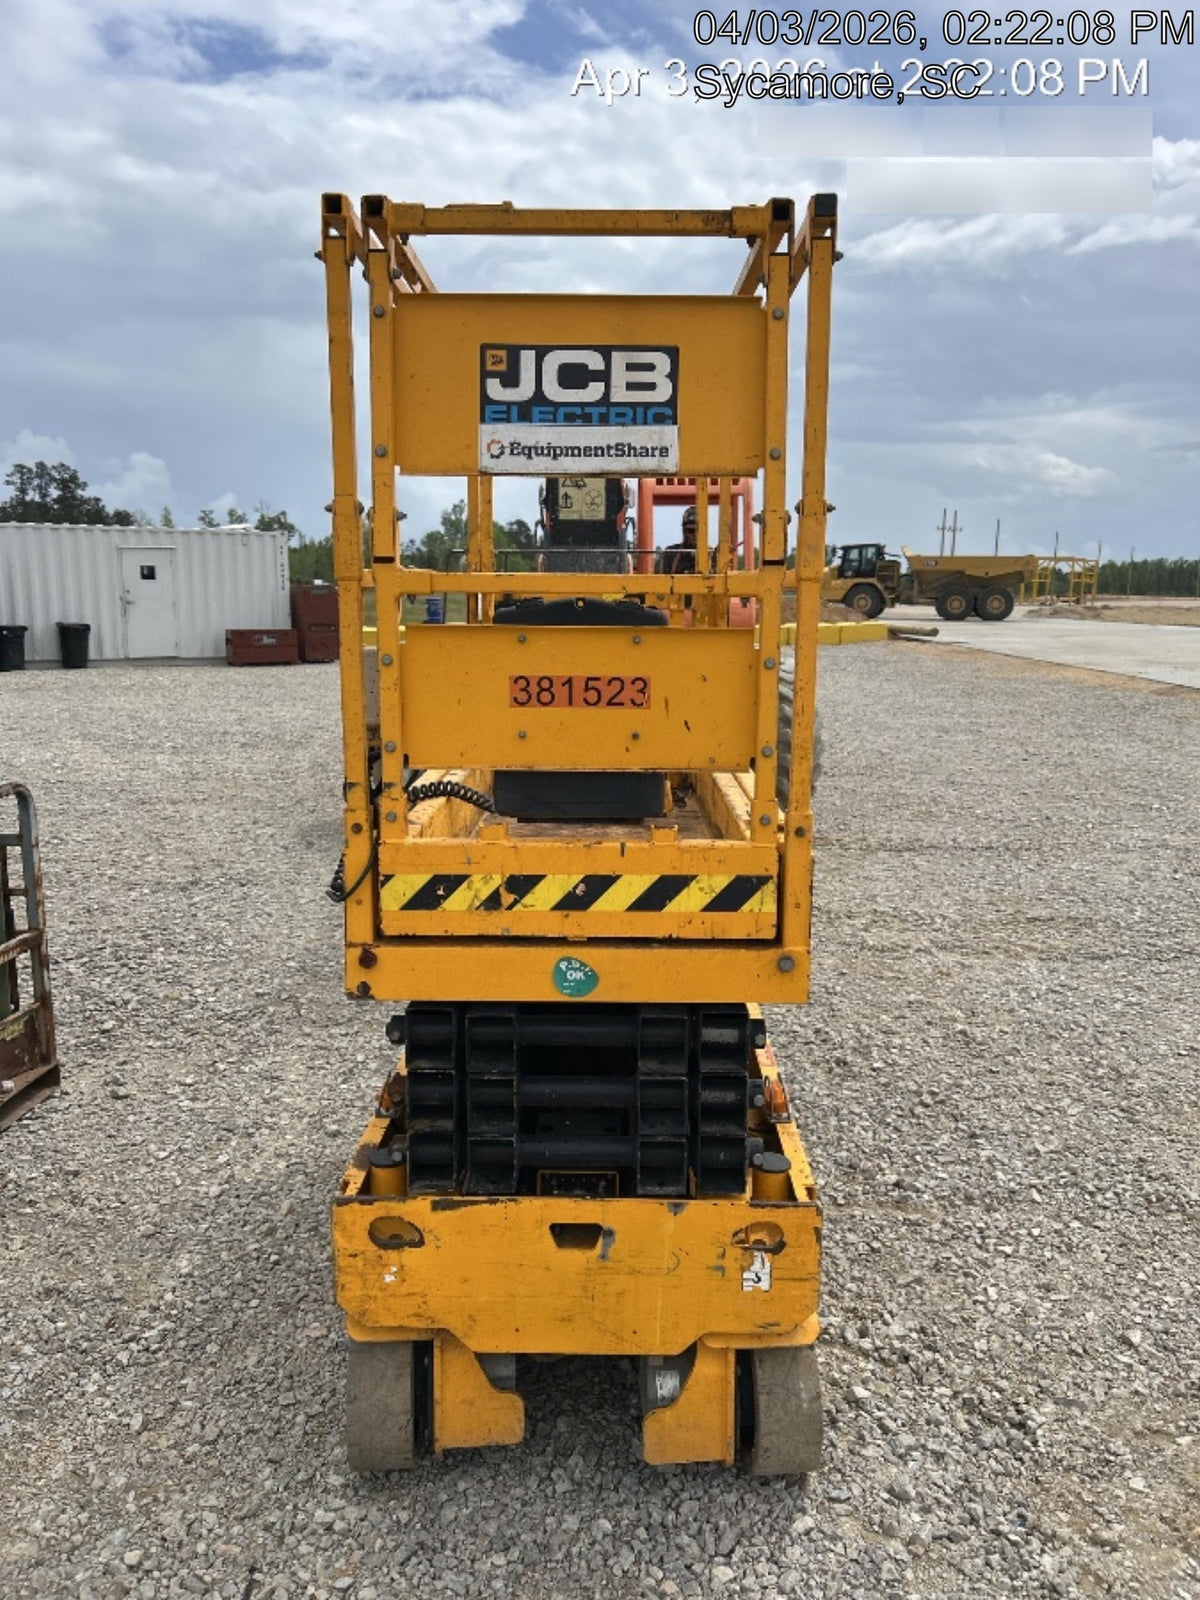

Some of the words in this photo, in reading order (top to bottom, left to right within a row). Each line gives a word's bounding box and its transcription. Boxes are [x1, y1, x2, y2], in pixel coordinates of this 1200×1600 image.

[485, 350, 673, 402] JCB
[484, 404, 673, 425] ELECTRIC
[508, 441, 670, 460] EquipmentShare
[513, 675, 648, 707] 381523
[566, 970, 585, 980] OK
